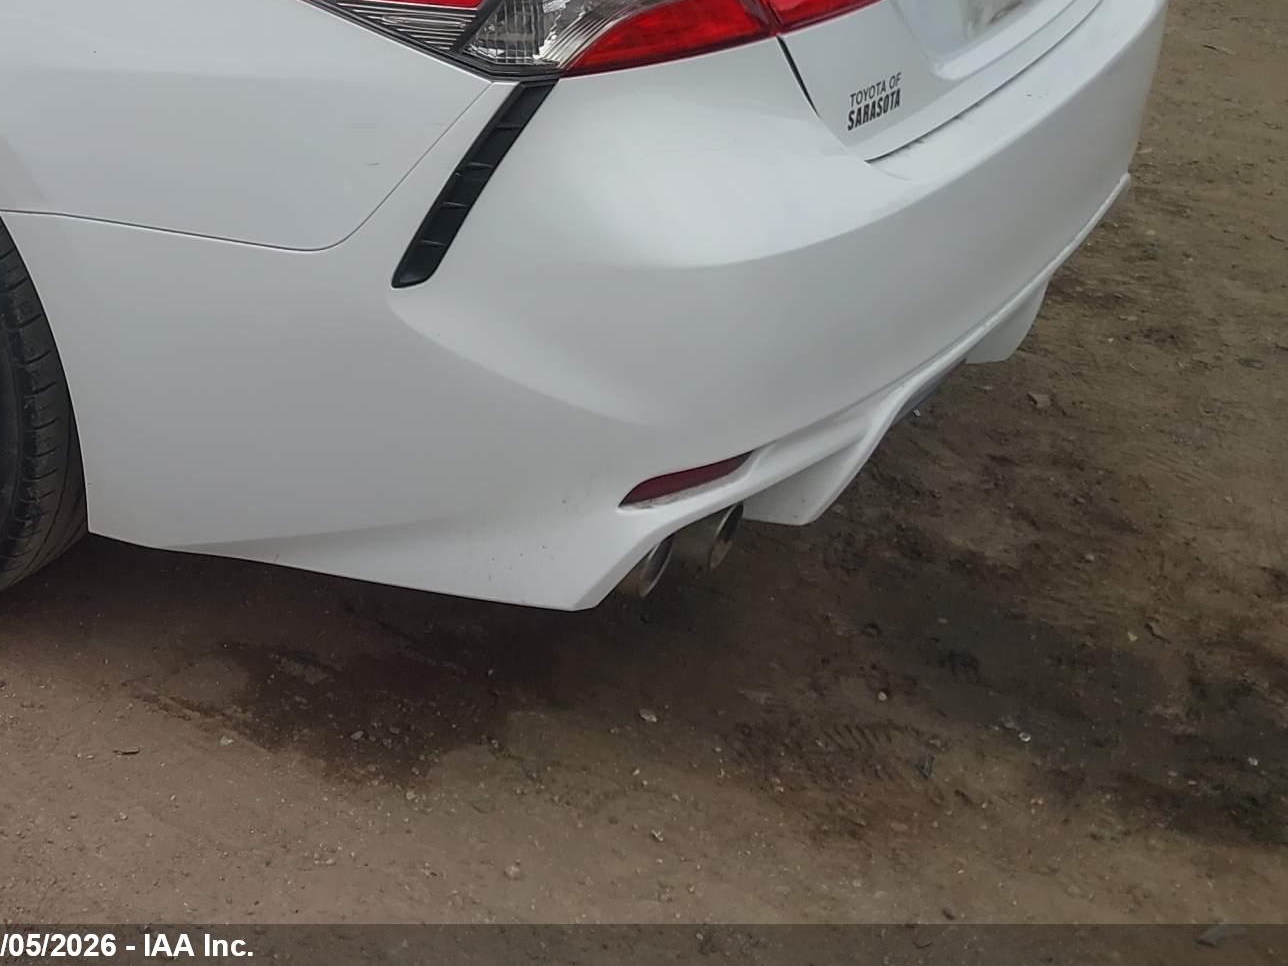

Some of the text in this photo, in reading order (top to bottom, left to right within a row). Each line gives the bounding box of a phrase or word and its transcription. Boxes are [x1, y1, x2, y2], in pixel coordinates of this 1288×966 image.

[847, 88, 901, 131] SARASOTA
[850, 72, 902, 108] TOYOTA OF
